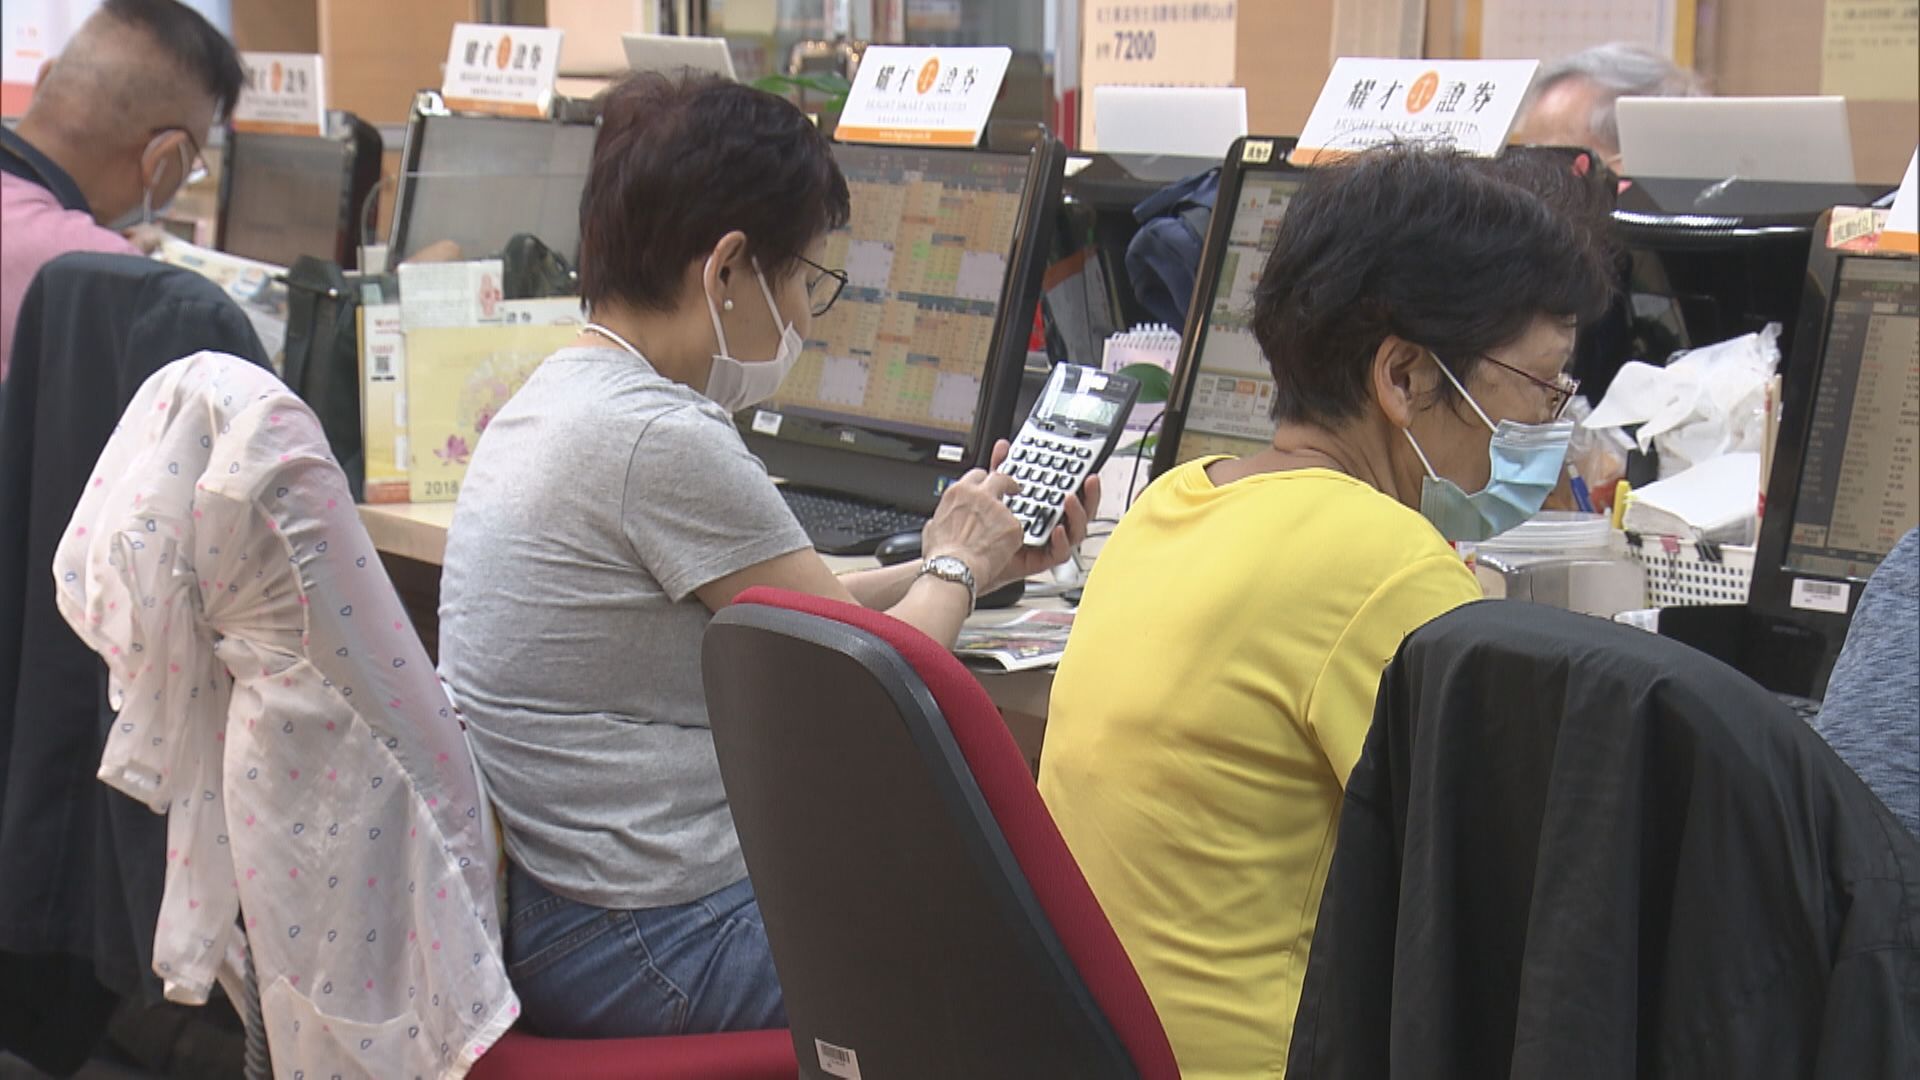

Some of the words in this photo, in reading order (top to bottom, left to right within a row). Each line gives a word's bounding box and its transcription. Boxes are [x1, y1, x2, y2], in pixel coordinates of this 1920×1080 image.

[1114, 30, 1157, 60] 7200
[1348, 78, 1496, 114] 耀才證券
[424, 480, 459, 496] 2018
